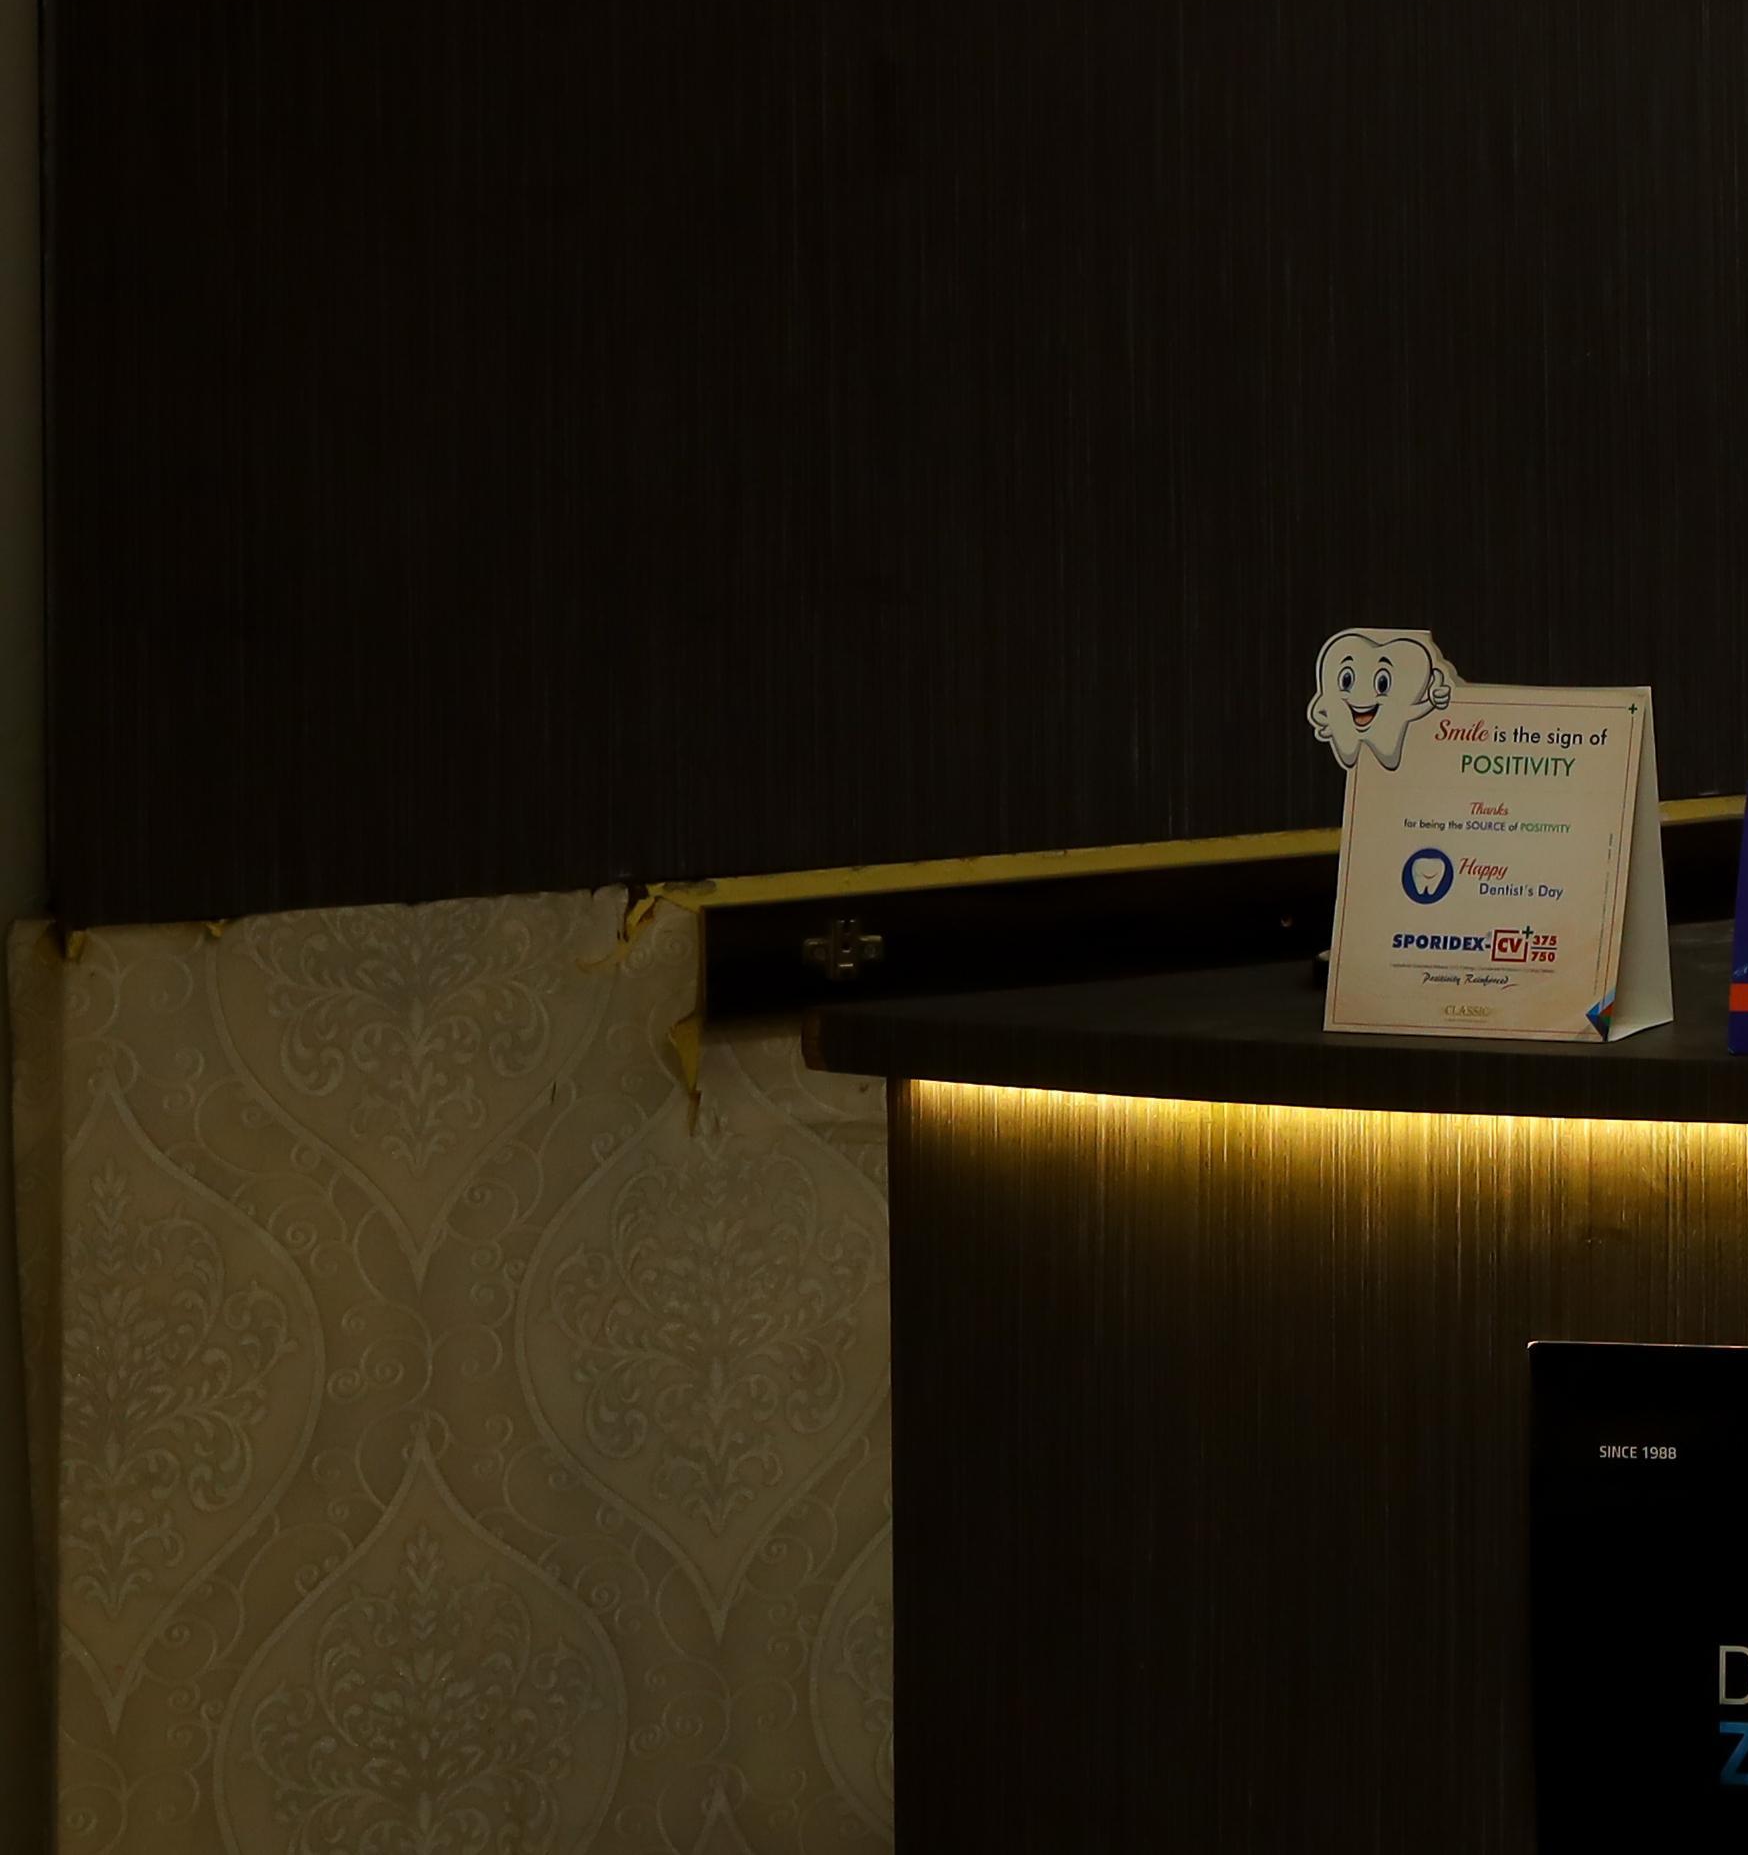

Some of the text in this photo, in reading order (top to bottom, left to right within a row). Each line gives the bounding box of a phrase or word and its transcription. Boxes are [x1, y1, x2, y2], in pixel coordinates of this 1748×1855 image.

[1434, 718, 1608, 747] Smile is the sign of
[1460, 753, 1576, 777] POSITIVITY
[1469, 801, 1509, 817] Thanks
[1404, 819, 1570, 834] for being the SOURCE of POSITIVITY
[1457, 857, 1509, 881] Happy
[1479, 881, 1564, 900] Dentist's Day
[1532, 935, 1557, 945] 375
[1531, 951, 1555, 962] 750
[1598, 1444, 1678, 1462] SINCE 1988
